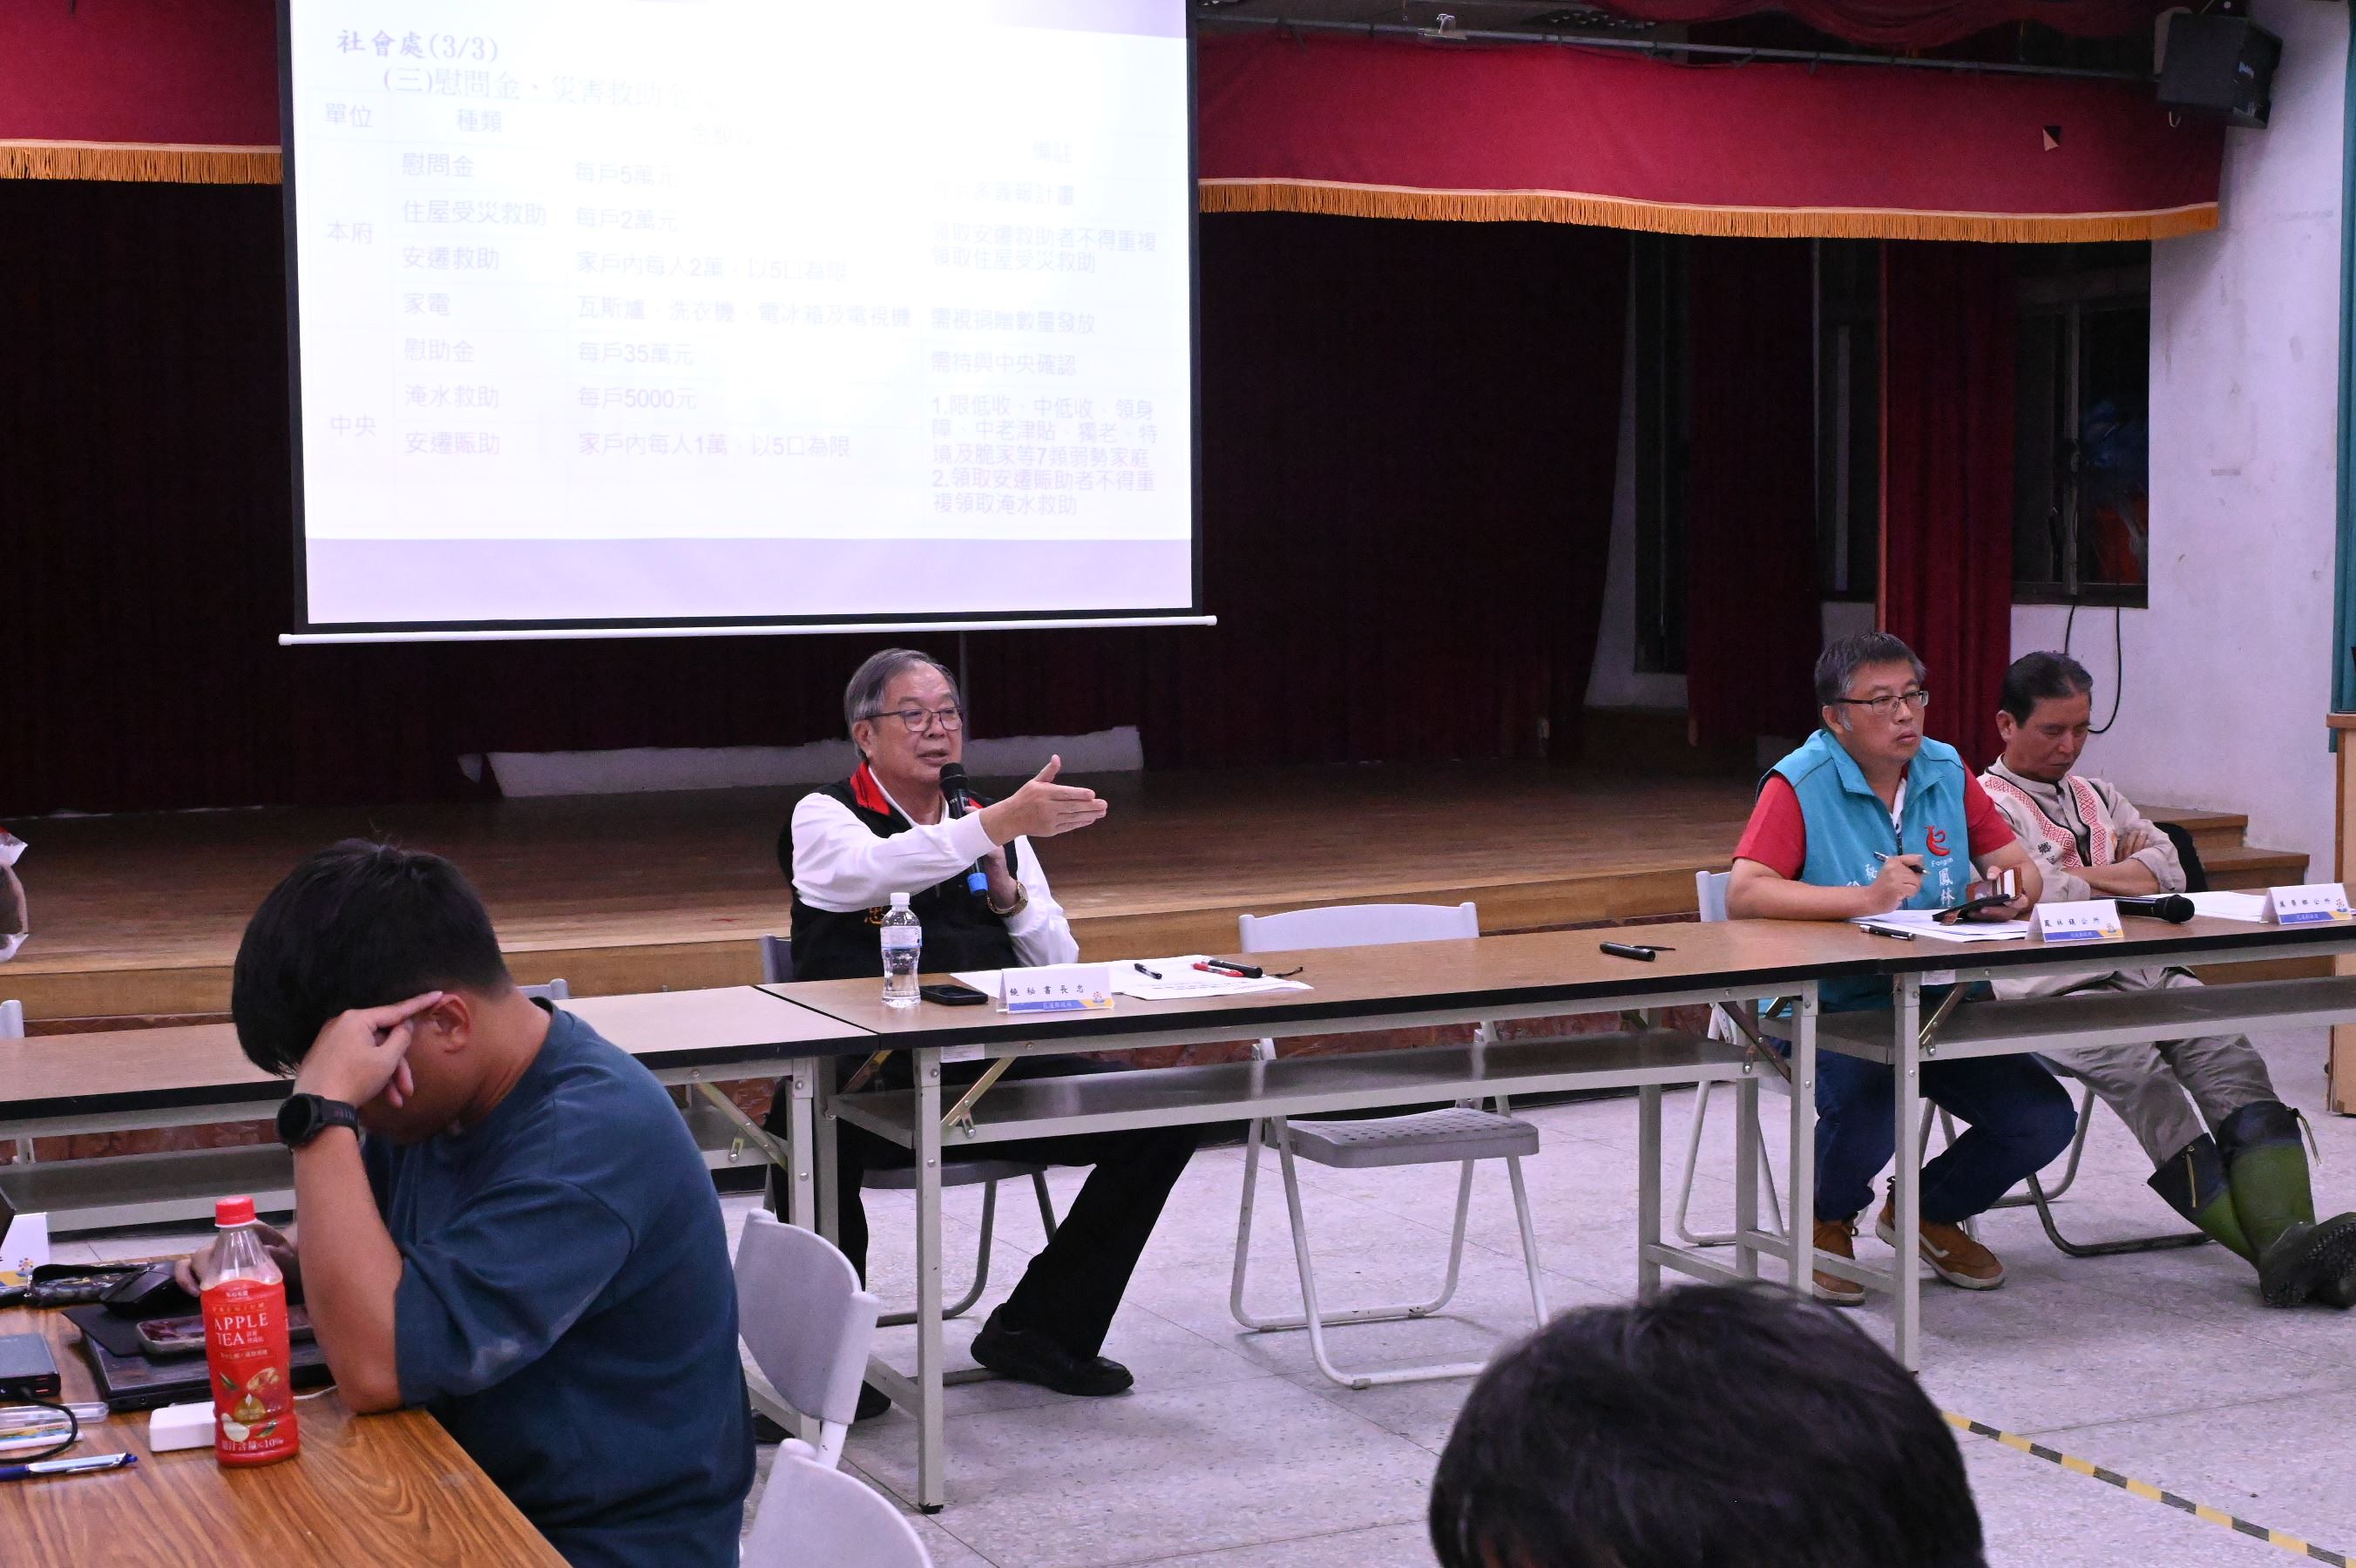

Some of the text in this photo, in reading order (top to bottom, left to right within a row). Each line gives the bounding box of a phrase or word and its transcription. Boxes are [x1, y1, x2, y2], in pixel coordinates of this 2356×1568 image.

[326, 103, 373, 129] 單位
[456, 109, 503, 133] 種類
[401, 152, 475, 179] 慰問金
[574, 161, 677, 187] 每戶5萬元
[402, 199, 546, 228] 住屋受災救助
[575, 209, 679, 233] 每戶2萬元
[328, 221, 373, 245] 本府
[402, 247, 499, 272] 安遷救助
[932, 247, 1096, 274] 領取住屋受災救助
[403, 293, 450, 317] 家電
[403, 338, 475, 363] 慰助金
[577, 342, 695, 366] 每戶35萬元
[931, 350, 1076, 376] 需待與中央確認
[403, 384, 499, 409] 淹水救助
[578, 388, 699, 410] 每戶5000元
[330, 415, 376, 438] 中央
[403, 432, 501, 456] 安遷賑助
[934, 493, 1078, 517] 複領取淹水救助
[214, 1312, 268, 1331] APPLE
[216, 1331, 245, 1347] TEA
